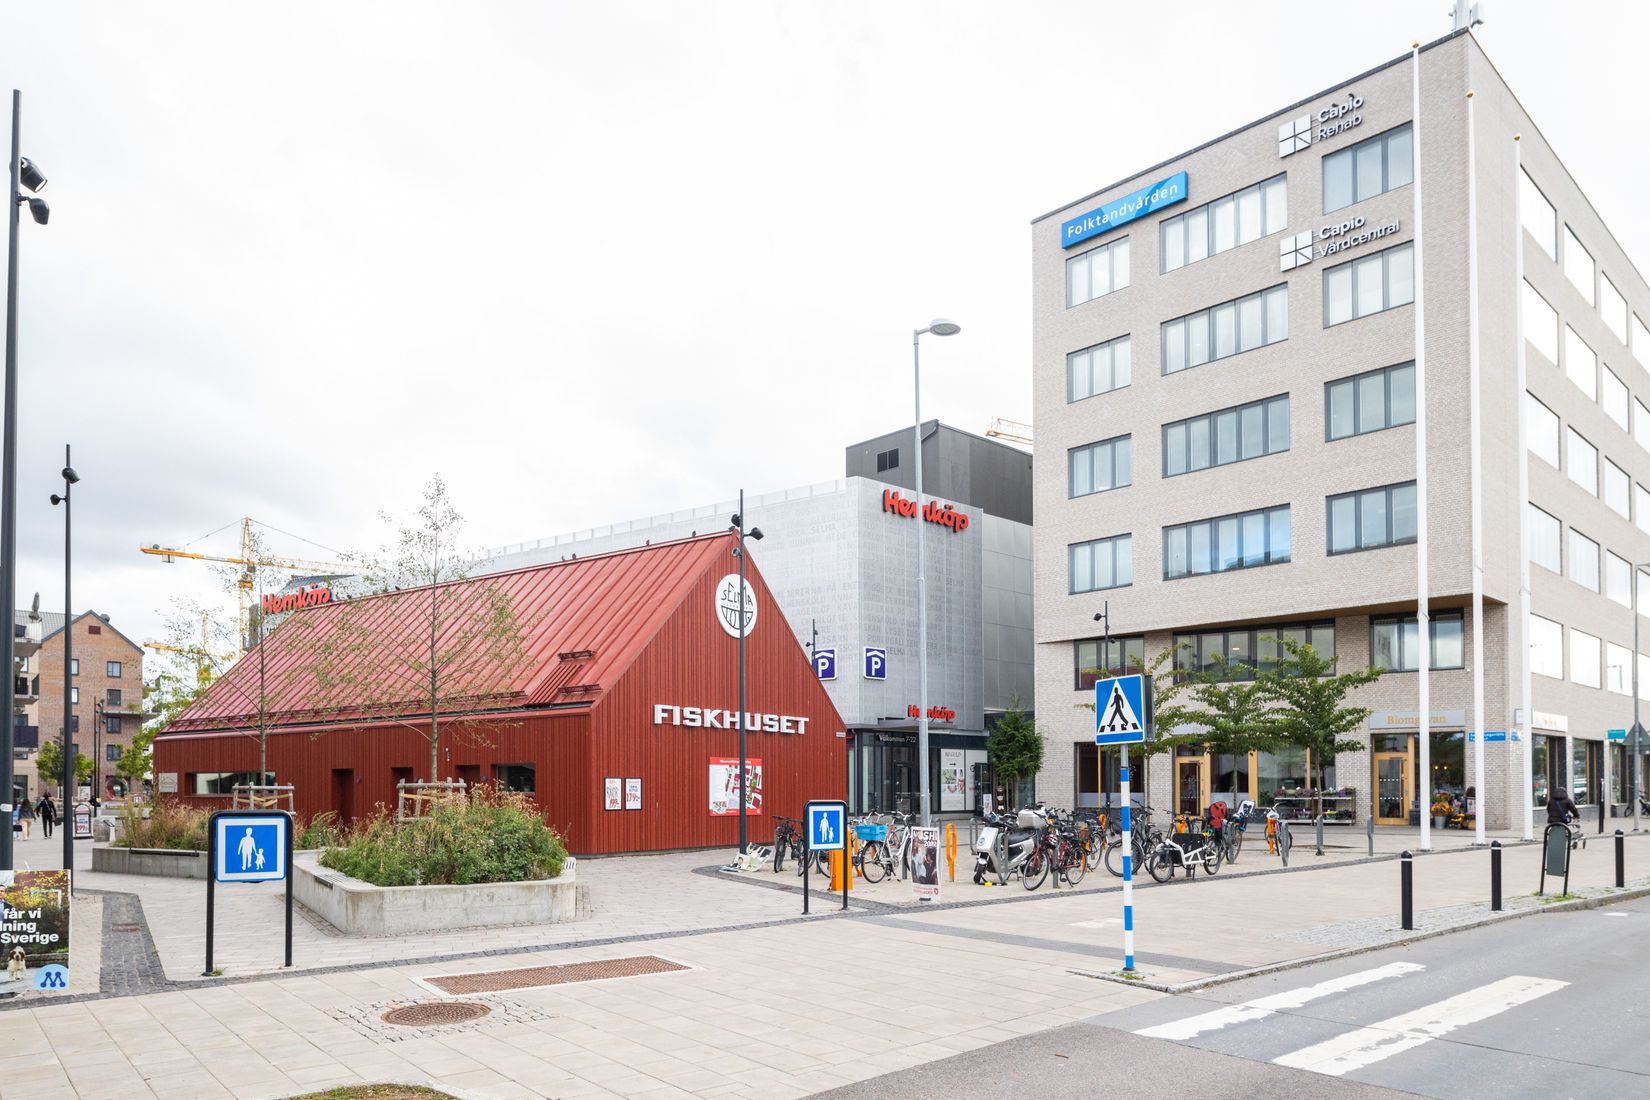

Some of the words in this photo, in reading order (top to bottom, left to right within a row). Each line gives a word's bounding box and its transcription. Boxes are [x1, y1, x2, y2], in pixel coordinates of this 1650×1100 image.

[1318, 96, 1364, 123] Capio
[1318, 114, 1363, 141] Rehab
[1067, 184, 1178, 238] Folktandvården
[1319, 216, 1366, 241] Capio
[1319, 218, 1400, 257] Vårdcentral
[883, 488, 969, 533] Hemköp
[262, 583, 333, 615] Hemköp
[818, 659, 829, 677] P
[872, 657, 881, 675] P
[653, 703, 810, 735] FISKHUSET
[0, 920, 37, 933] ning
[3, 907, 26, 920] får
[28, 907, 42, 919] vi
[0, 931, 60, 945] Sverige
